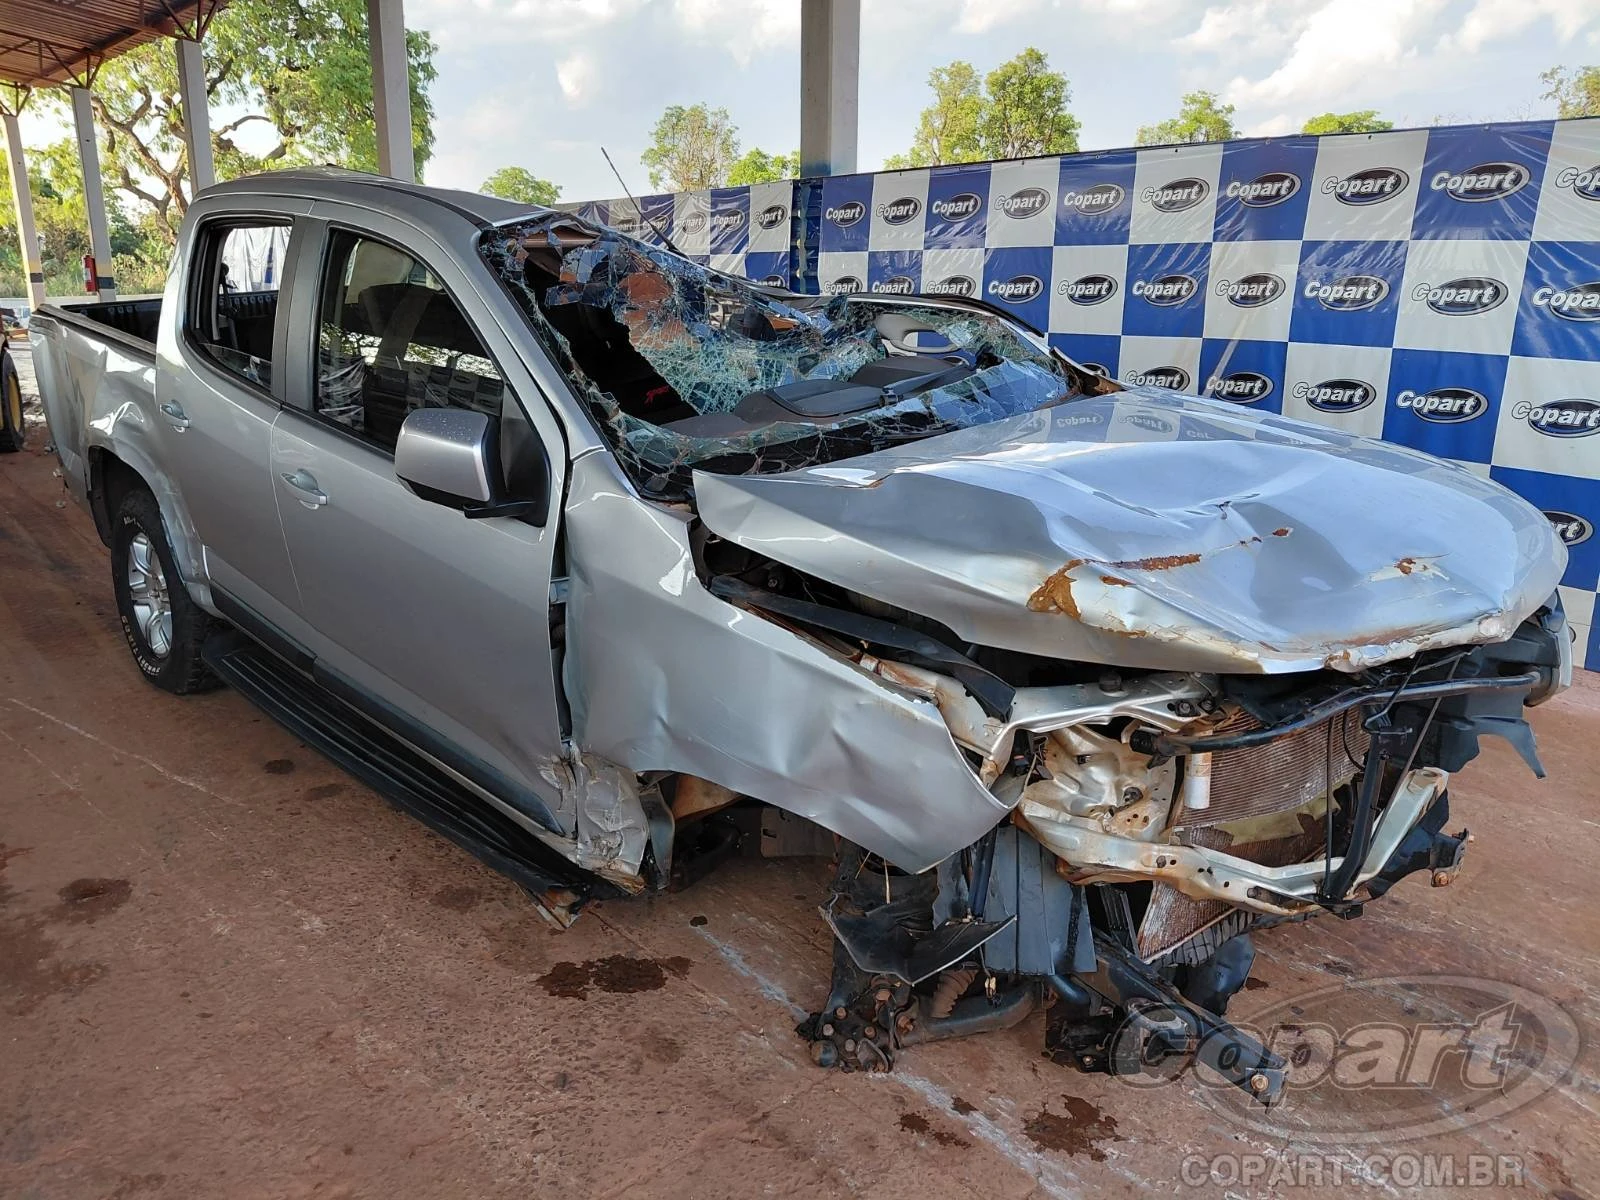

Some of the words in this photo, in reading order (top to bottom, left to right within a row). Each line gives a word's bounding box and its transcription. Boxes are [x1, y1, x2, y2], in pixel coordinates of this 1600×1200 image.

[1226, 176, 1292, 200] Copart
[1321, 174, 1398, 196] Copart
[1430, 169, 1518, 193] Copart
[1555, 166, 1600, 192] Cop
[994, 193, 1042, 211] Copart
[1063, 189, 1119, 209] Copart
[1140, 183, 1199, 206] Copart
[825, 205, 861, 221] Copart
[876, 201, 915, 218] Copart
[932, 199, 975, 216] Copart
[713, 213, 741, 227] Copart
[824, 281, 857, 294] Copart
[872, 281, 911, 294] Copart
[926, 281, 968, 295] Copart
[988, 280, 1037, 298] Copart
[1057, 280, 1110, 298] Copart
[1132, 281, 1191, 298] Copart
[1215, 279, 1274, 299] Copart
[1304, 280, 1378, 301] Copart
[1411, 283, 1496, 306] Copart
[1532, 287, 1600, 312] Copa
[1125, 370, 1181, 388] Copart
[1206, 374, 1264, 395] Copart
[1292, 381, 1364, 404] Copart
[1396, 389, 1476, 415] Copart
